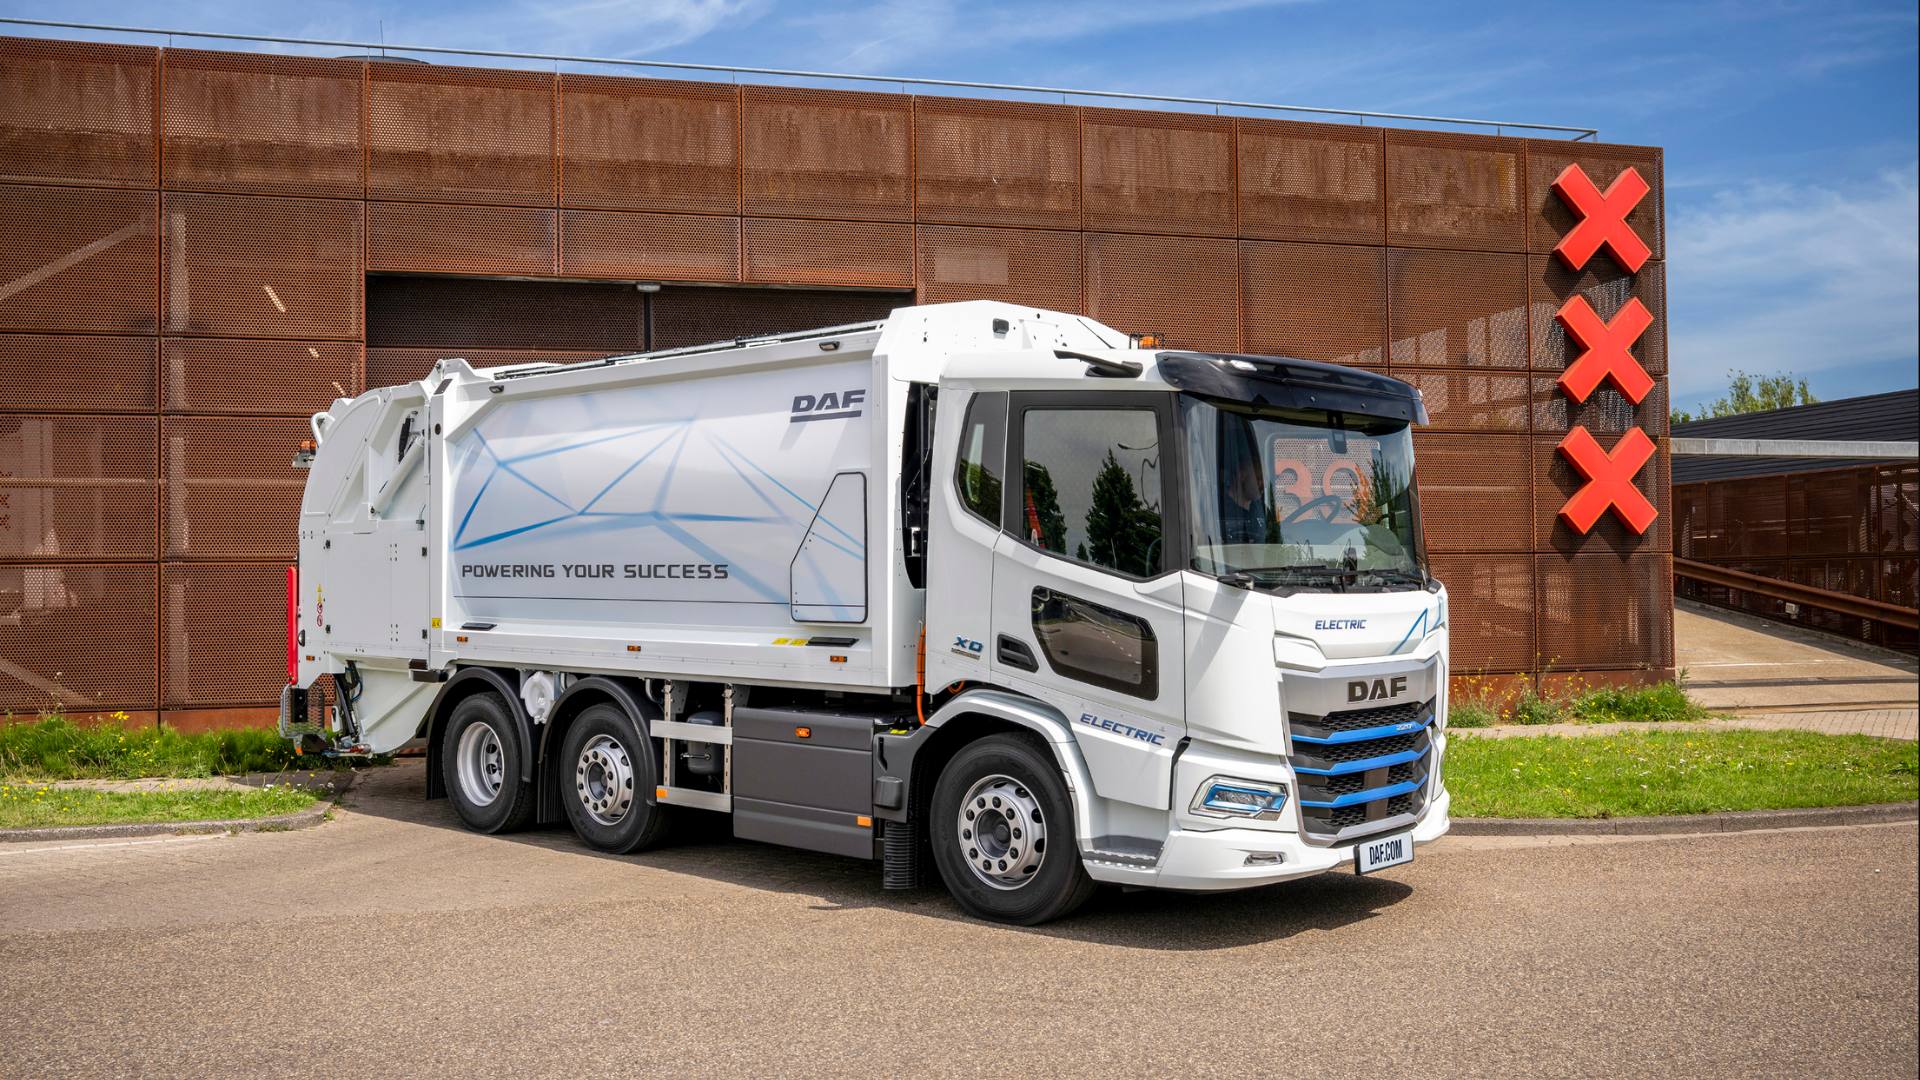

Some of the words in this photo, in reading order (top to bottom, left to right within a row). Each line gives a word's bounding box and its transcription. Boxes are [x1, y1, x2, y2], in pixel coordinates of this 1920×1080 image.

[791, 389, 866, 413] DAF
[461, 563, 555, 578] POWERING
[562, 563, 615, 579] YOUR
[623, 563, 729, 580] SUCCESS
[1314, 619, 1367, 630] ELECTRIC
[953, 635, 983, 653] XD
[1347, 676, 1408, 703] DAF
[1080, 712, 1166, 746] ELECTRIC
[1368, 838, 1403, 866] DAF.COM
